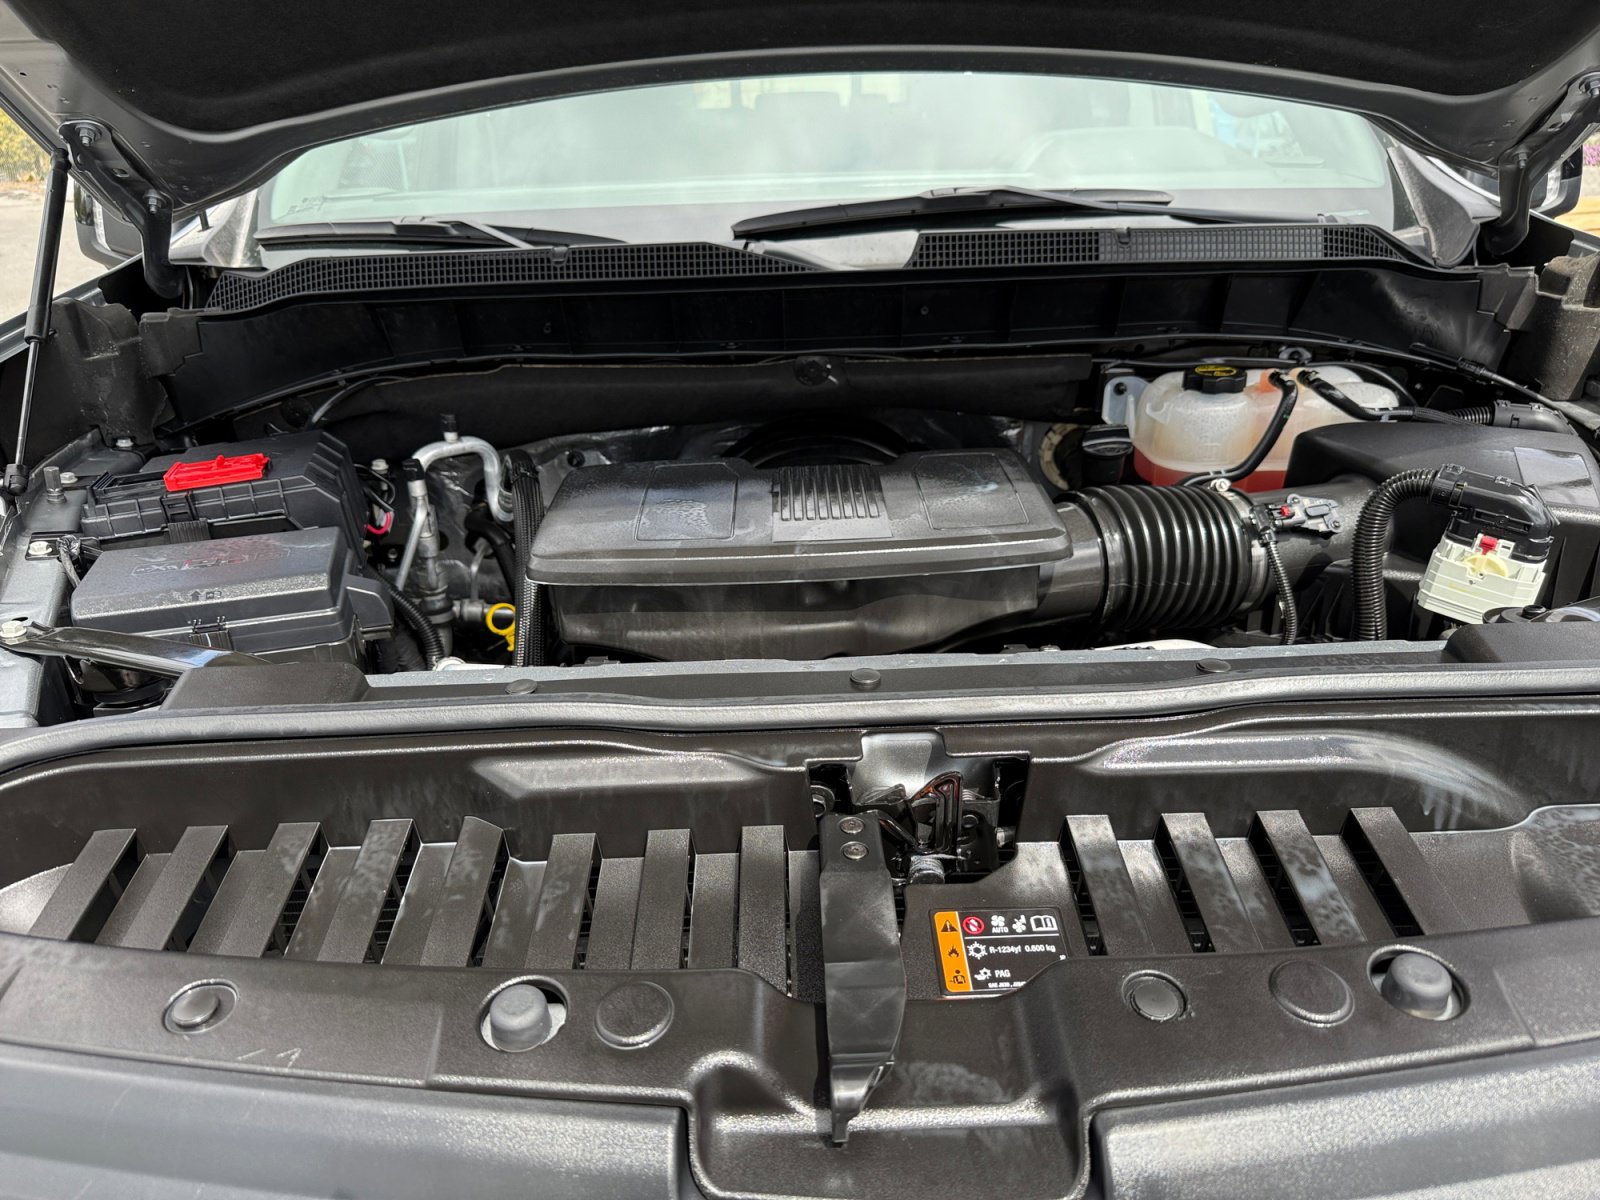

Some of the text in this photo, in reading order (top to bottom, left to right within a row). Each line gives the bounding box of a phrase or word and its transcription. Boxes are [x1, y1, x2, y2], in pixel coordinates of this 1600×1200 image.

[989, 945, 1021, 954] R-1234yf
[1045, 943, 1056, 952] kg
[994, 969, 1011, 977] PAG
